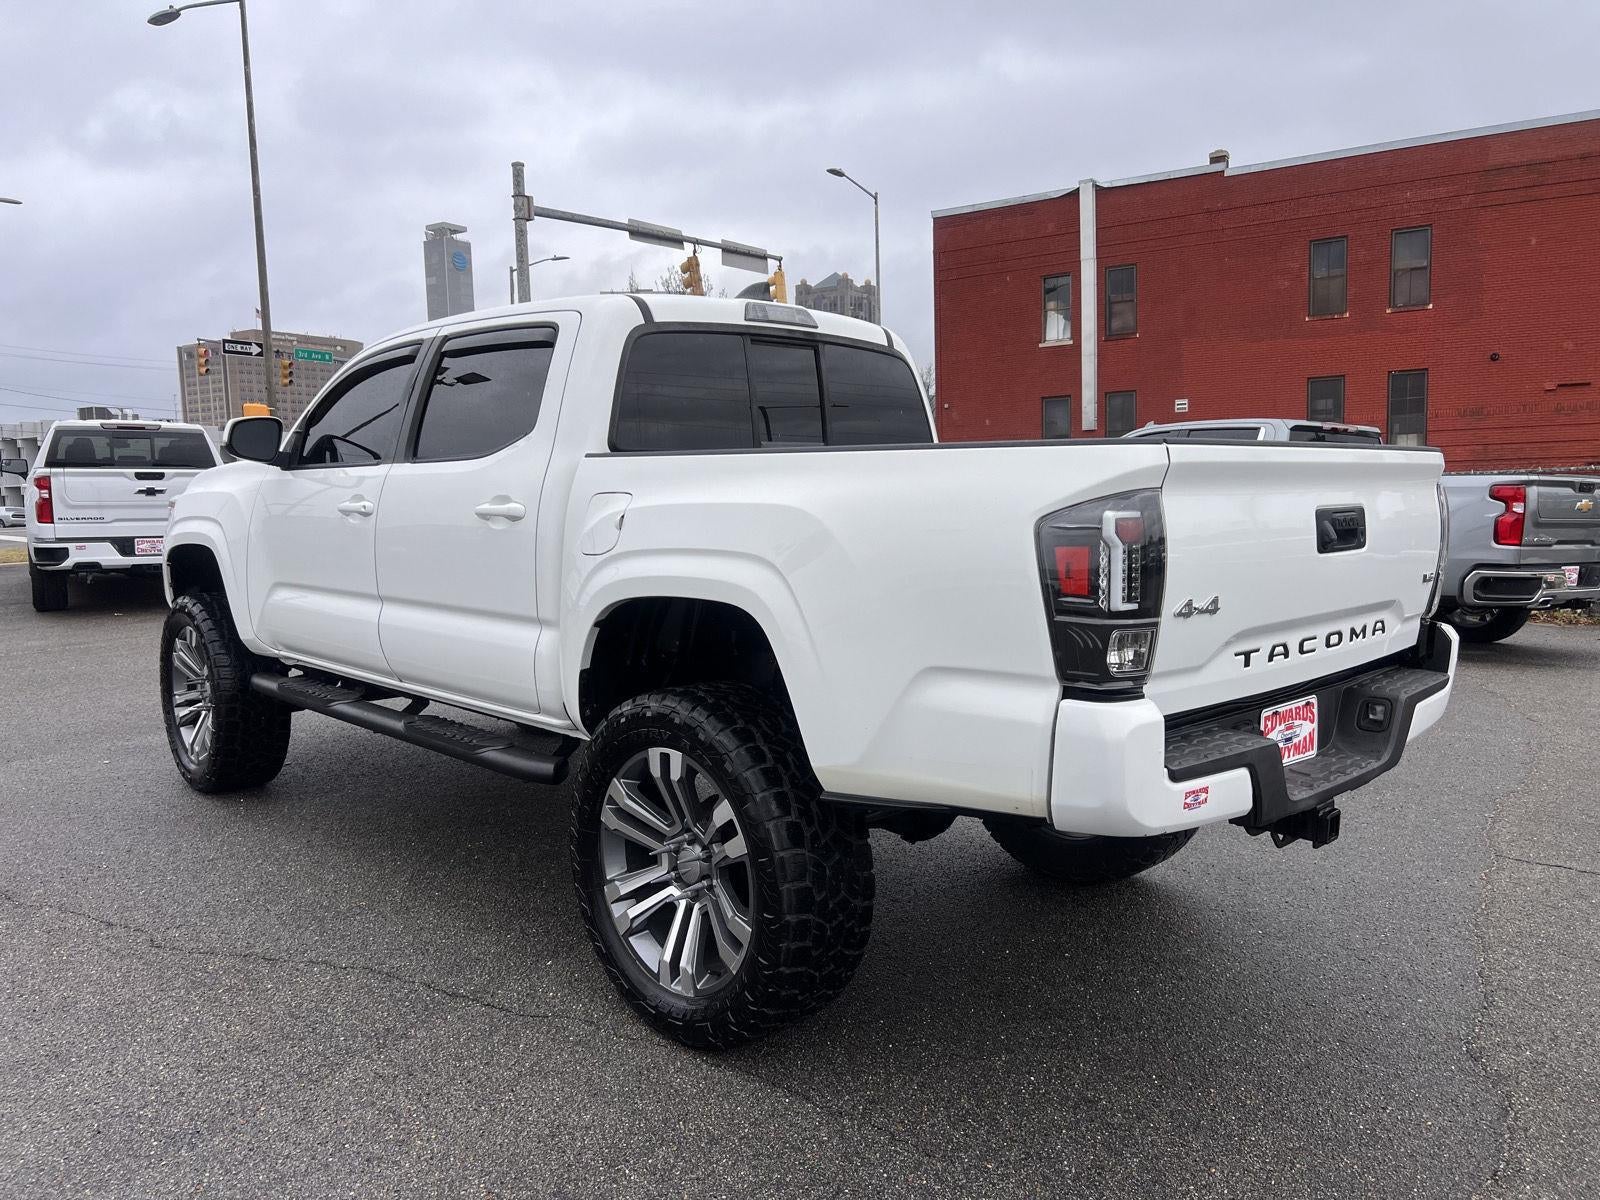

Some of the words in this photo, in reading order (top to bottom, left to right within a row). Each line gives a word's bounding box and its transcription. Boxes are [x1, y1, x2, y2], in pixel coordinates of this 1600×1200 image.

[226, 343, 239, 351] ONE
[297, 350, 308, 359] 3rd
[1233, 618, 1387, 669] TACOMA
[1263, 702, 1316, 738] EDWARDS
[1280, 727, 1315, 761] VYMAN
